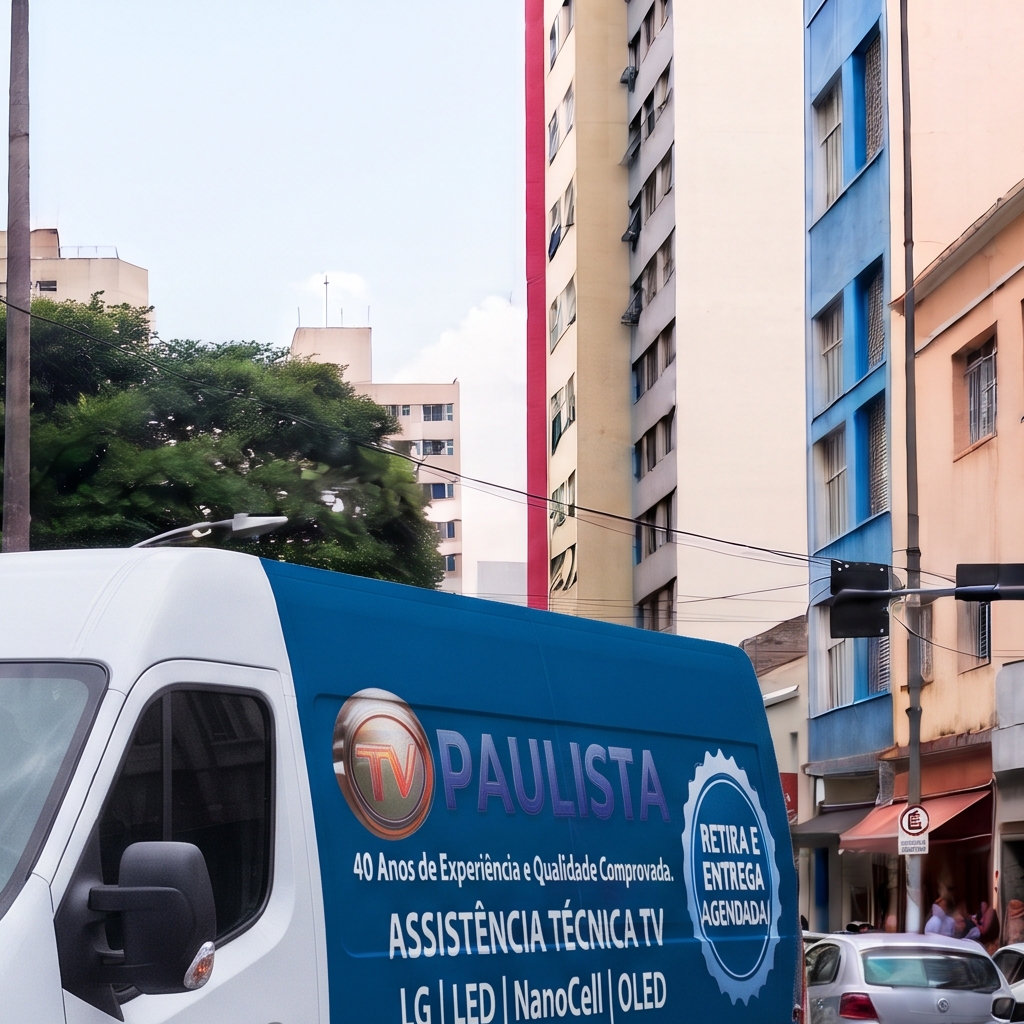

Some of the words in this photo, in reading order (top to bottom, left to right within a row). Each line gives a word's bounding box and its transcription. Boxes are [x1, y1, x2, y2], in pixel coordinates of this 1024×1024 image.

[355, 743, 417, 802] TV
[435, 728, 671, 823] PAULISTA
[699, 823, 750, 855] RETIRA
[750, 826, 761, 855] E
[353, 852, 374, 882] 40
[377, 851, 416, 882] Anos
[418, 851, 438, 881] de
[439, 852, 521, 888] Experiência
[523, 862, 532, 881] e
[533, 853, 598, 887] Qualidade
[599, 856, 675, 889] Comprovada.
[702, 861, 765, 891] ENTREGA
[389, 900, 547, 960] ASSISTÊNCIA
[547, 898, 638, 953] TÉCNICA
[638, 908, 664, 948] TV
[701, 900, 769, 927] AGENDADA
[514, 972, 603, 1021] NanoCell
[618, 971, 667, 1013] OLED
